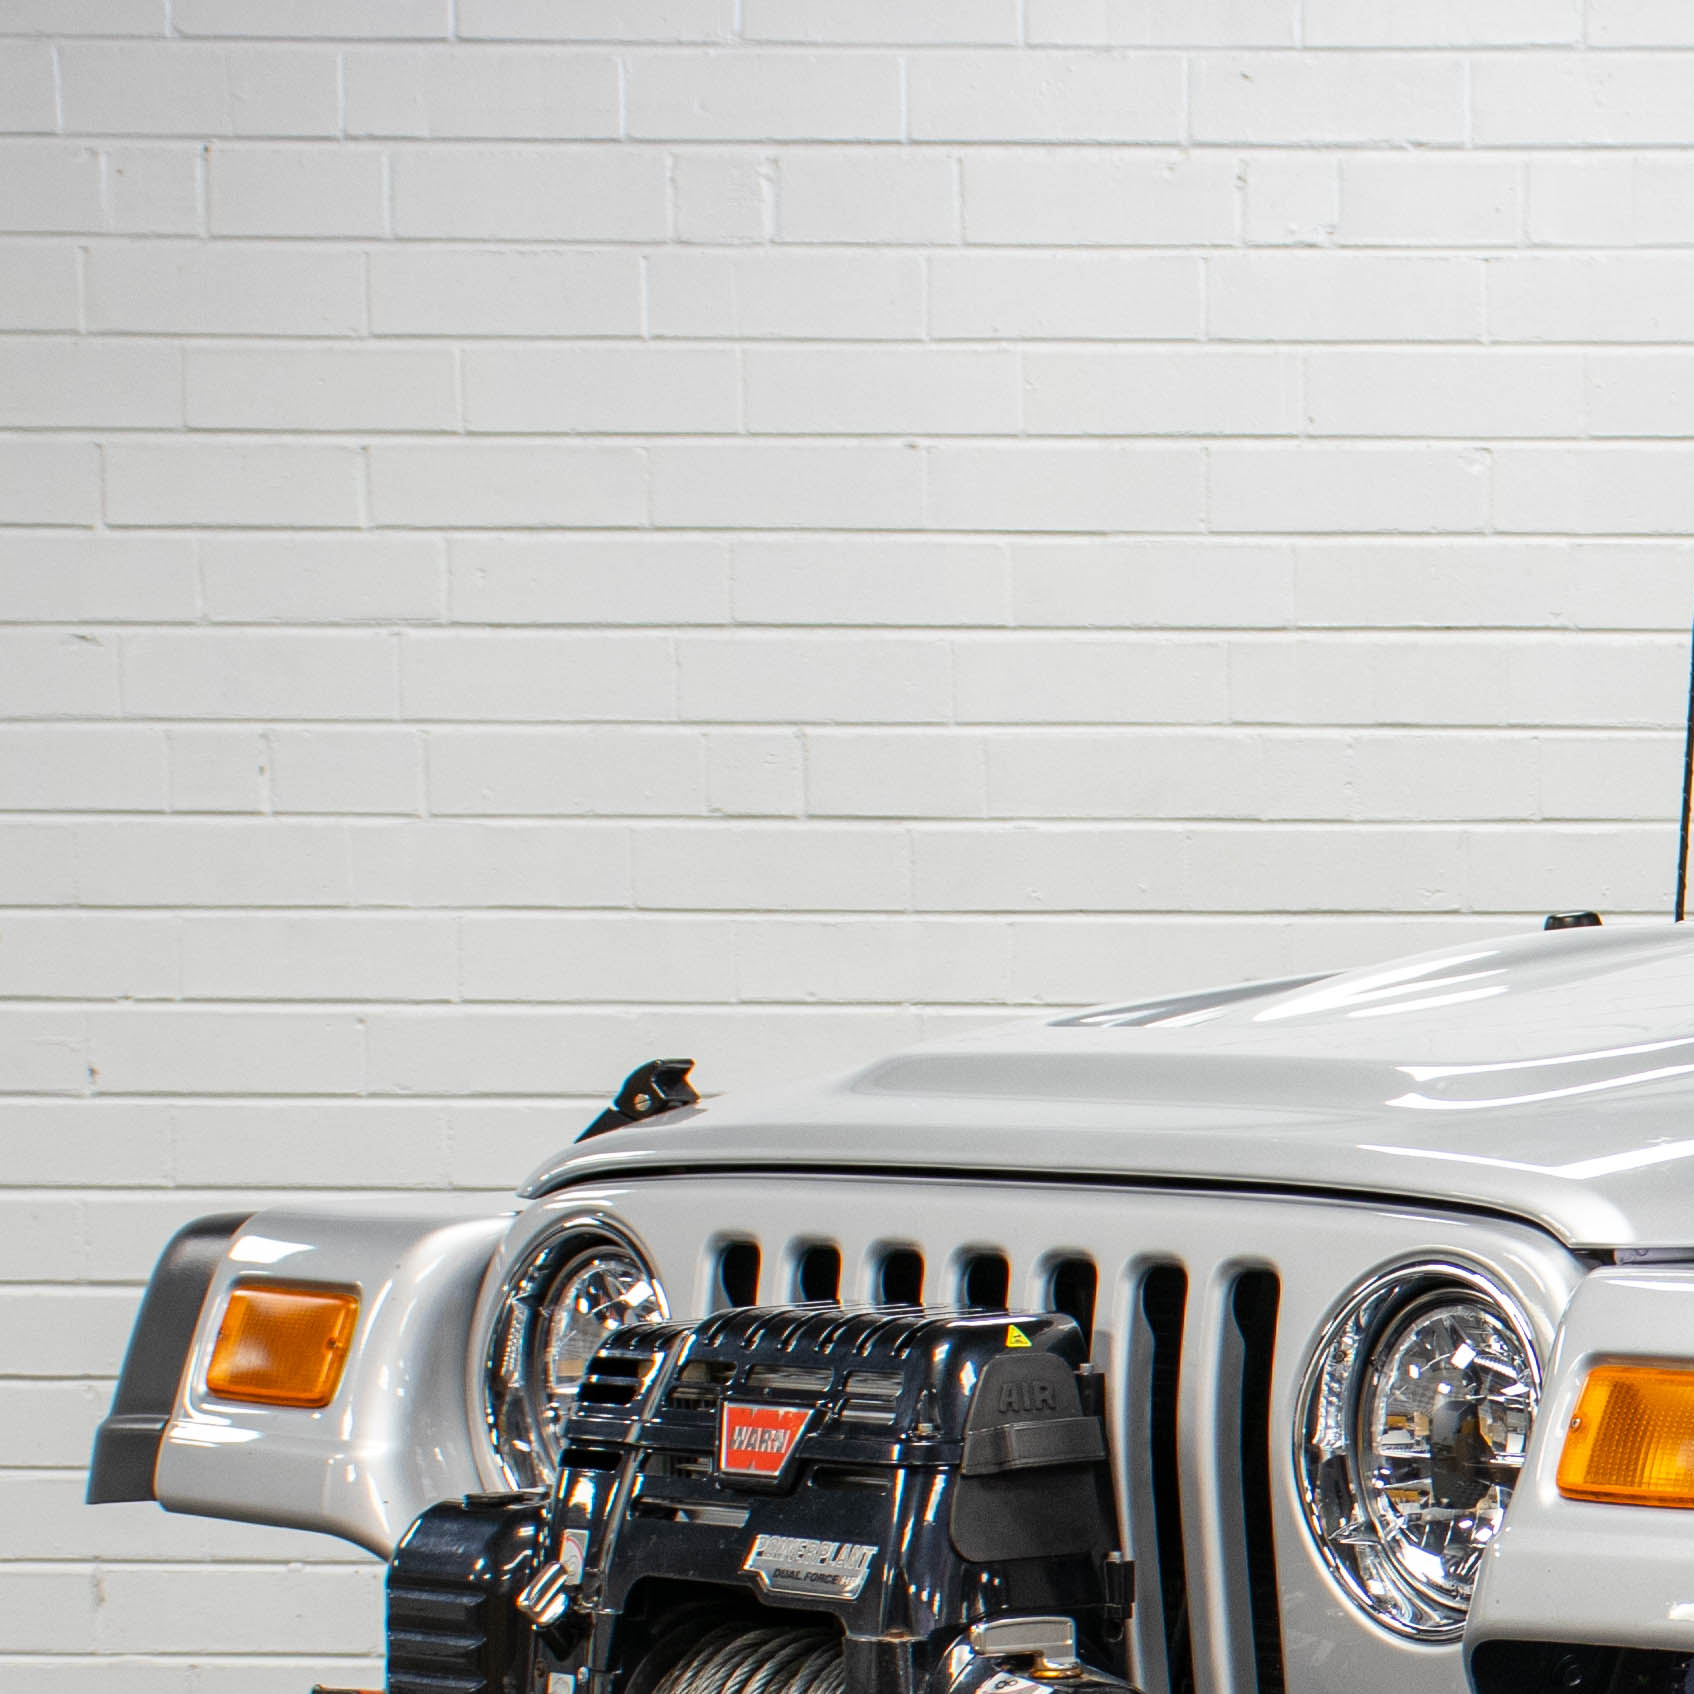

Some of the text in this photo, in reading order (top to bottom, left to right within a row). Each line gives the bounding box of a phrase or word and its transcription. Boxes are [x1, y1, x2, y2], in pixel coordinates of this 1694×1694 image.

[998, 1382, 1057, 1414] AIR
[729, 1426, 792, 1454] WARN
[752, 1533, 880, 1571] POWERPLANT
[772, 1567, 801, 1580] DUAL
[803, 1570, 839, 1585] FORCE
